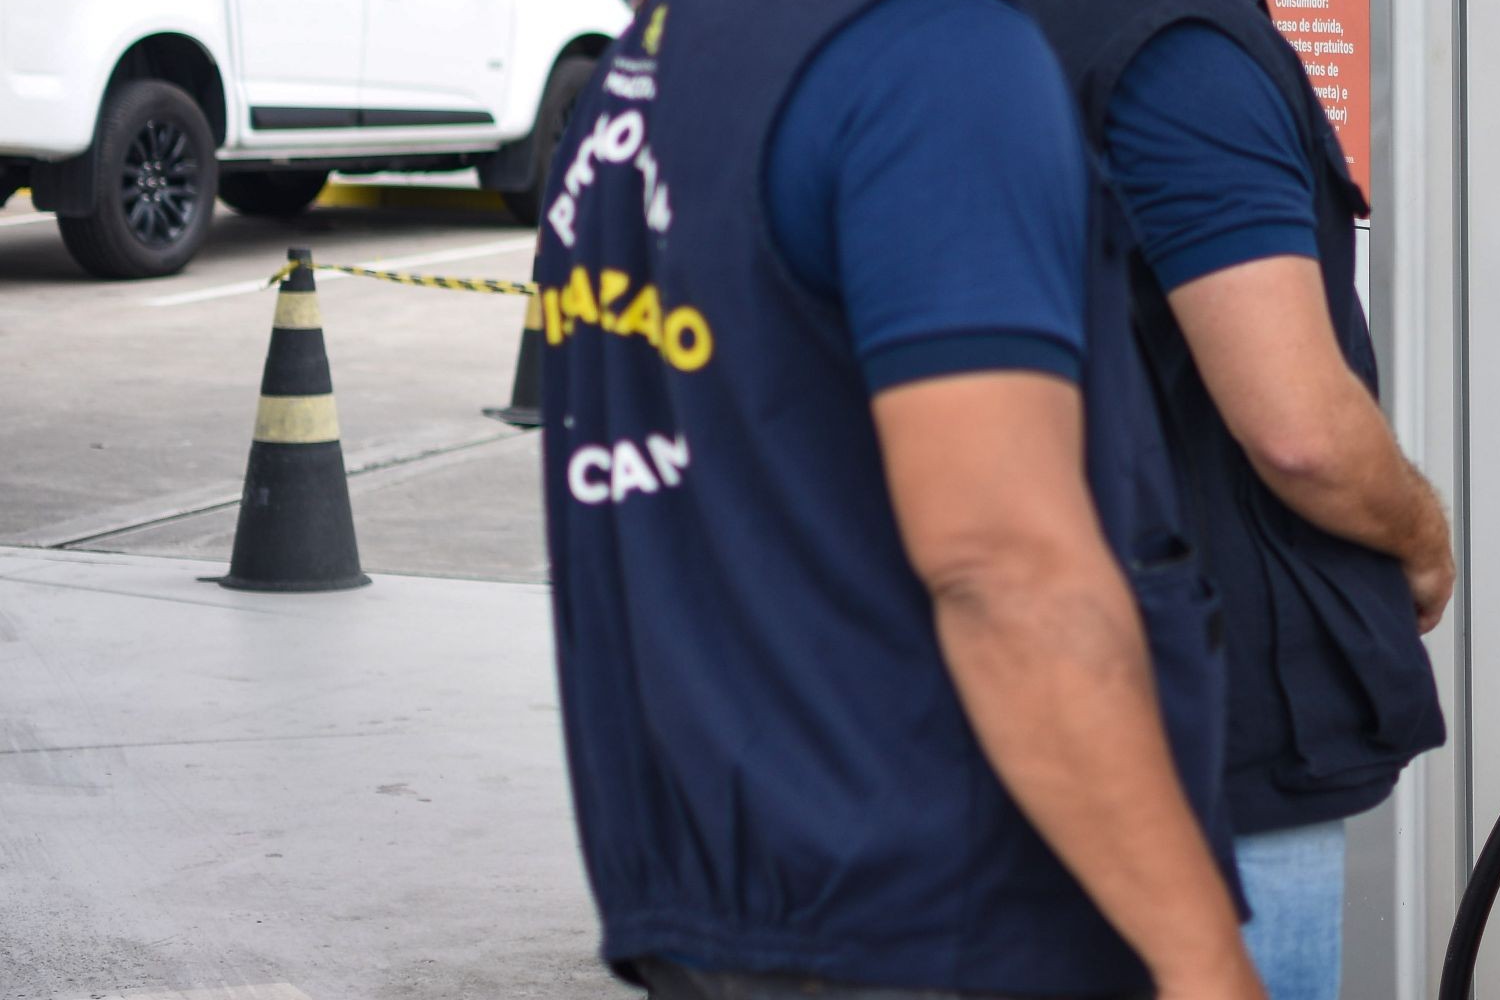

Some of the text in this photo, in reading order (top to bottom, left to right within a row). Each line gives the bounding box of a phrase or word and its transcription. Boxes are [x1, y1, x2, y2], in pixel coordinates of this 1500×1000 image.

[1276, 18, 1344, 36] caso de dúvida,
[1314, 37, 1354, 57] gratuitos
[1327, 62, 1339, 77] de
[1342, 88, 1348, 100] e
